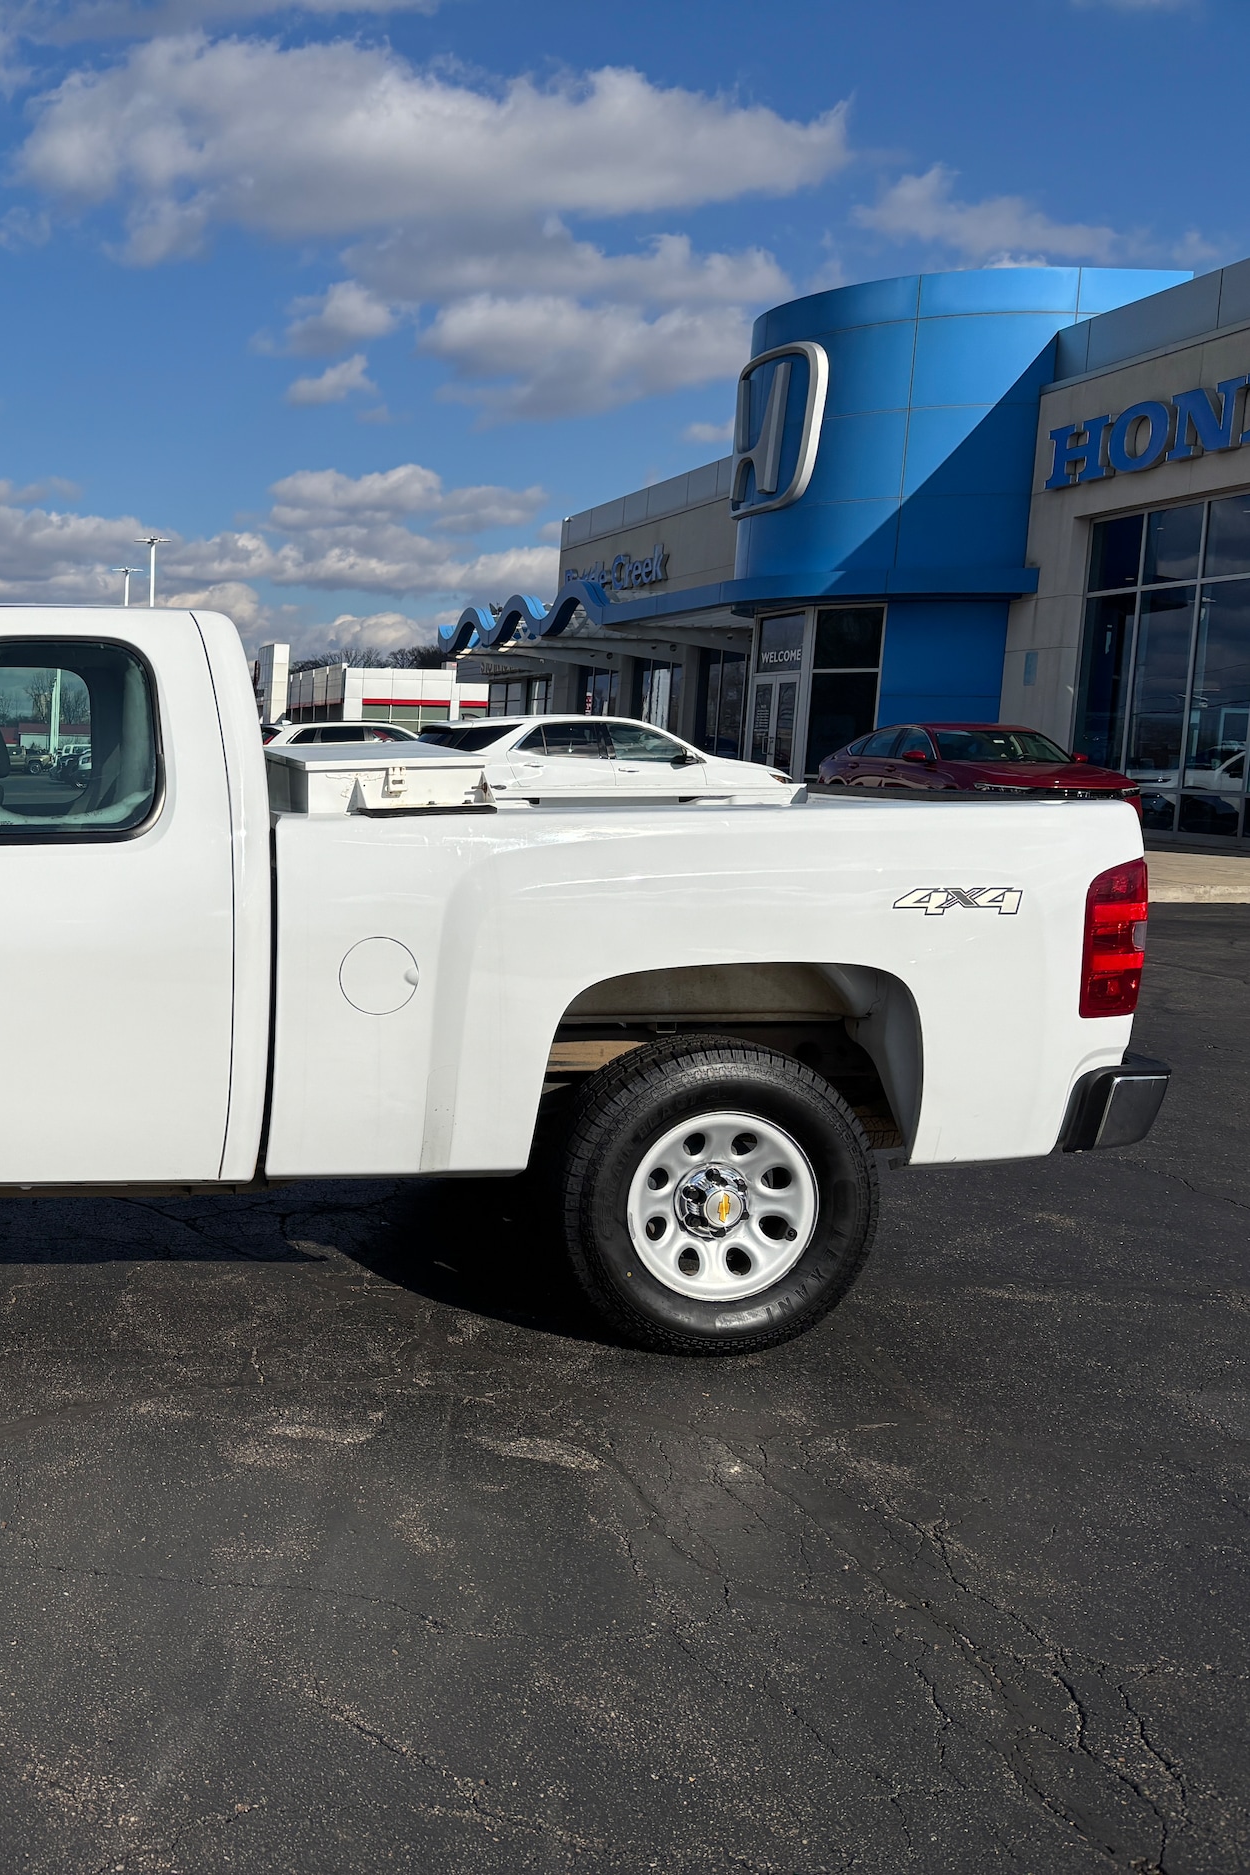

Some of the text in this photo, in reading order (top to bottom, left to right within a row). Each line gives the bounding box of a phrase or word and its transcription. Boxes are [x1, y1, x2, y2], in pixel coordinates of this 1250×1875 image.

[1044, 373, 1250, 490] HON
[611, 544, 669, 590] Creek
[761, 649, 802, 663] WELCOME
[892, 887, 1024, 916] 4X4
[765, 1228, 845, 1326] LEXANI
